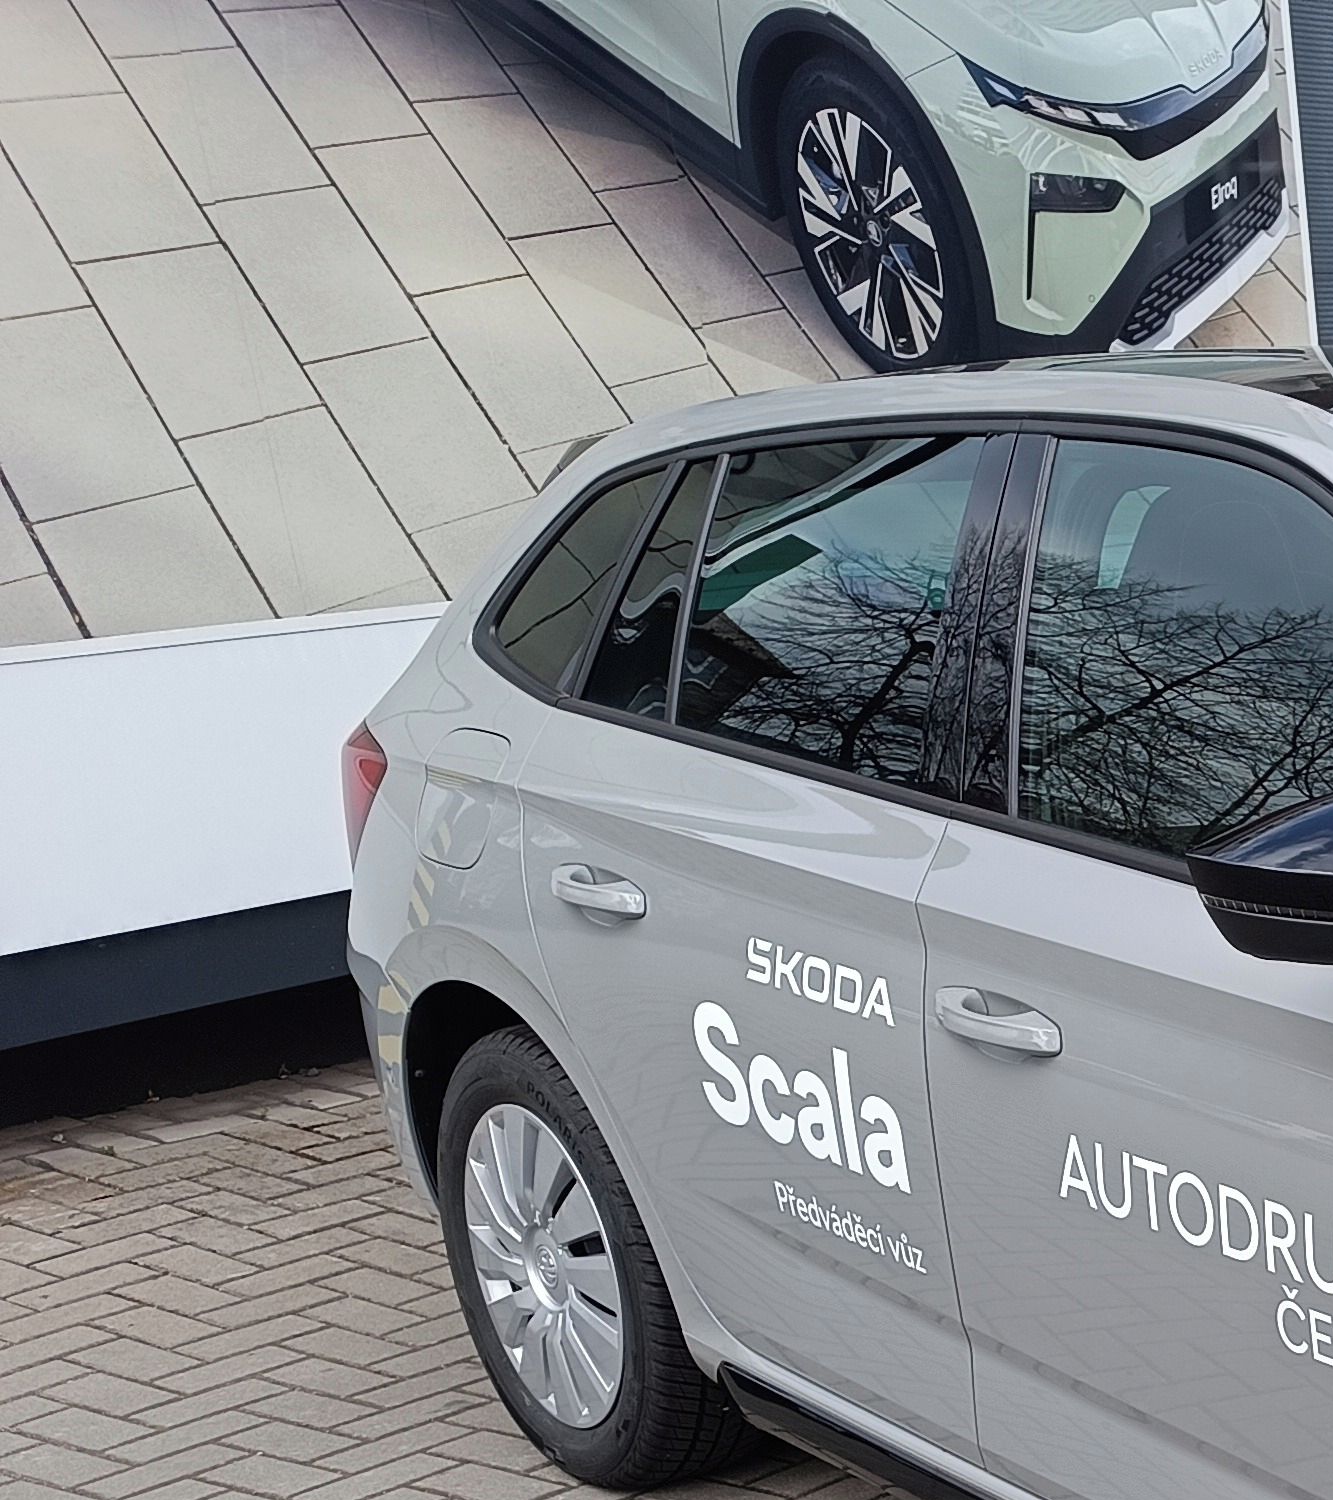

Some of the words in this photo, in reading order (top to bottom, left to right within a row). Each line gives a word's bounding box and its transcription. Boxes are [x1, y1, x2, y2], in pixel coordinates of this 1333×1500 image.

[1210, 175, 1238, 211] Elroq
[693, 1001, 912, 1195] Scala
[774, 1180, 886, 1256] Předváděcí
[886, 1232, 928, 1275] vůz
